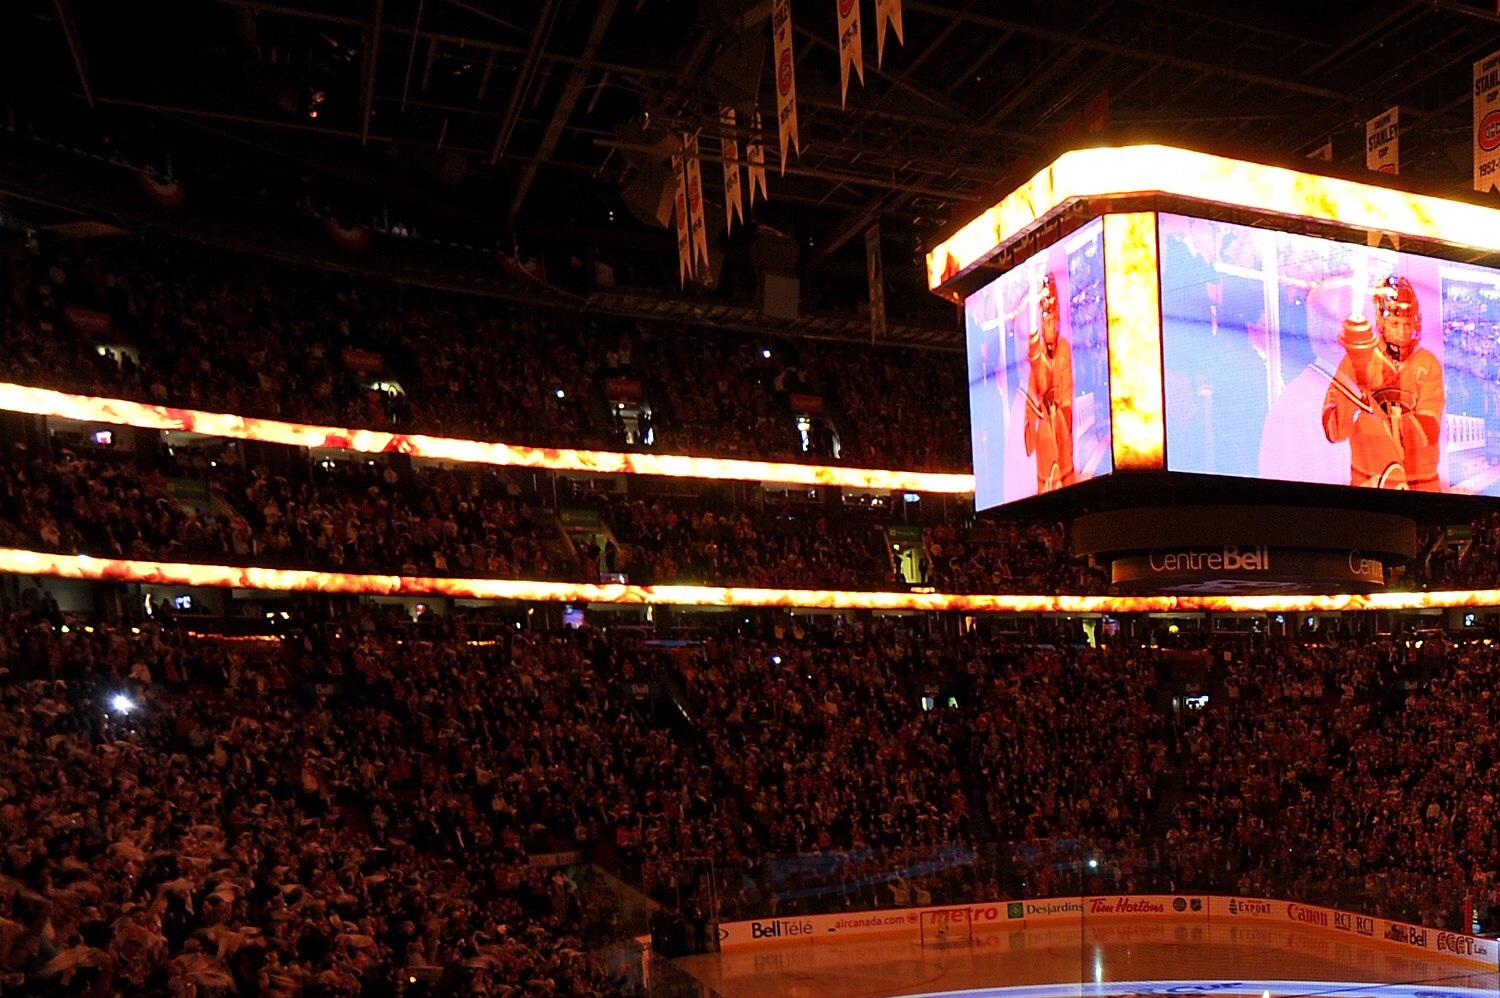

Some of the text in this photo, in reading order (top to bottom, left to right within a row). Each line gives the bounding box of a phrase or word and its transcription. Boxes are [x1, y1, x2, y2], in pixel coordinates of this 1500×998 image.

[1487, 90, 1499, 103] CUP
[1026, 902, 1084, 916] Desjardins
[1090, 898, 1164, 914] Tim Hortons
[835, 915, 904, 929] aircanada.com
[1287, 903, 1328, 927] Canon
[1334, 911, 1374, 933] RCI RCI
[1409, 926, 1427, 948] Bell
